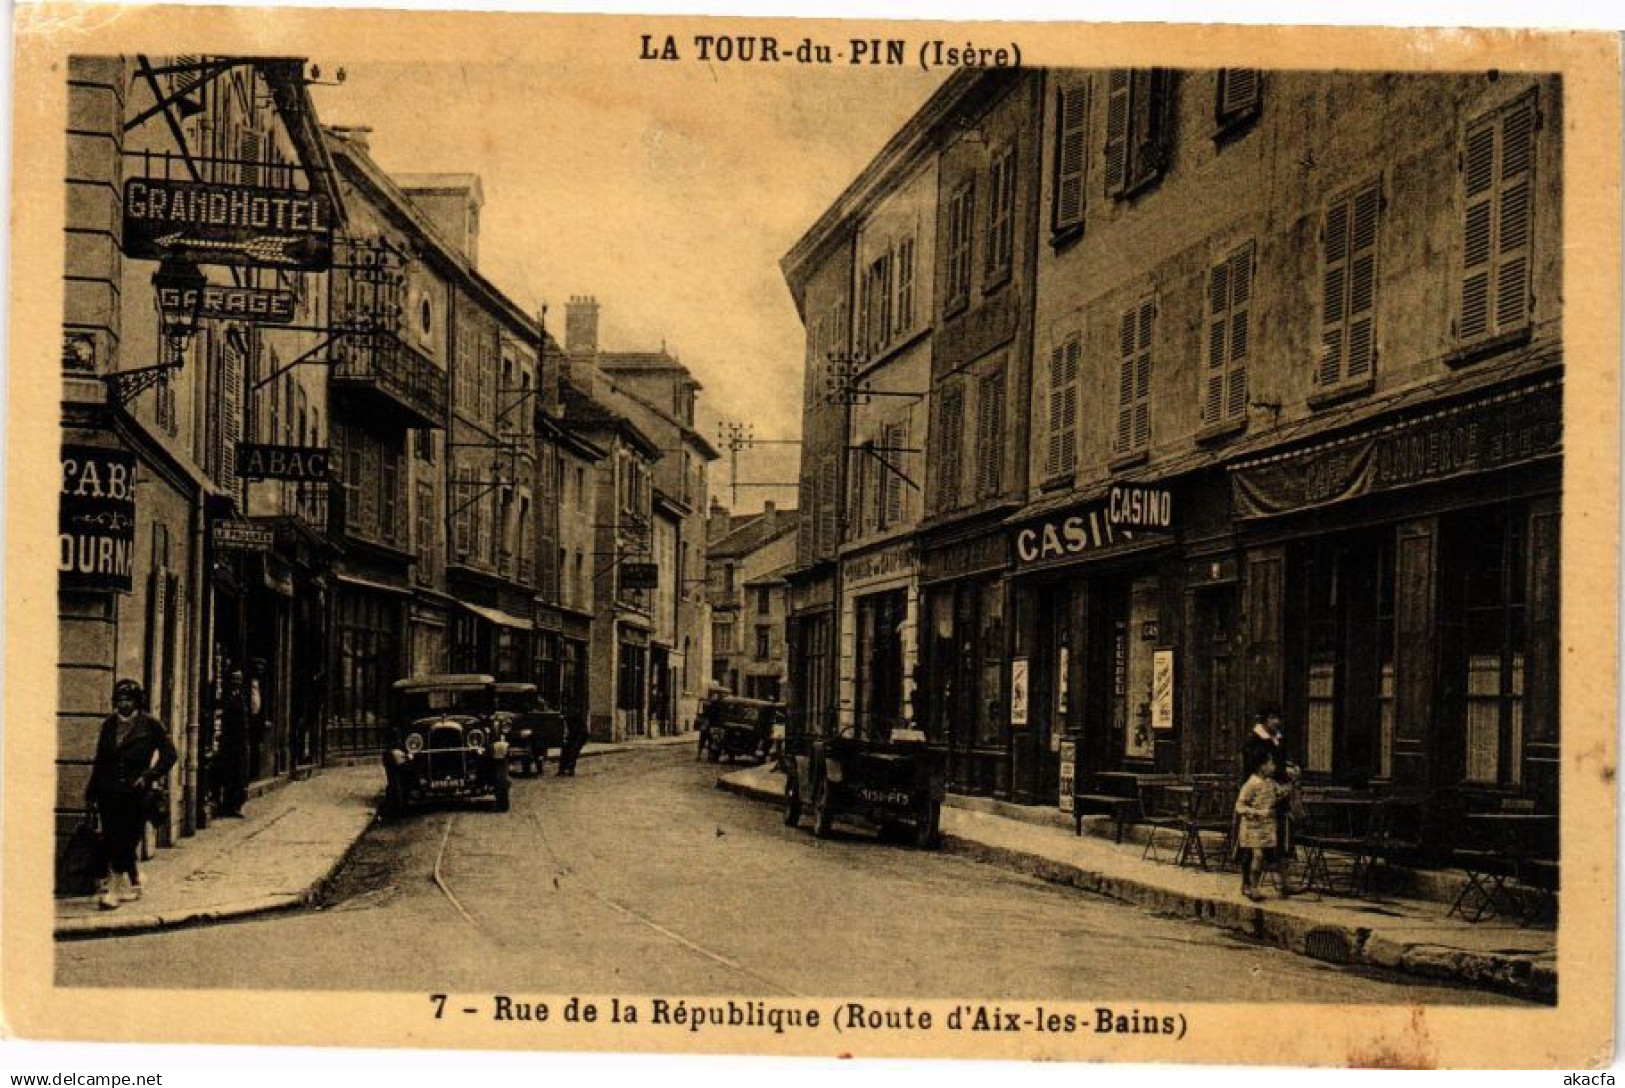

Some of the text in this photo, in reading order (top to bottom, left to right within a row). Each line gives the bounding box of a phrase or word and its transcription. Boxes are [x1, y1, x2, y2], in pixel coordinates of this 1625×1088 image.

[159, 288, 292, 314] GARAGE
[234, 449, 324, 477] ABAC
[1110, 487, 1171, 527] CASINO
